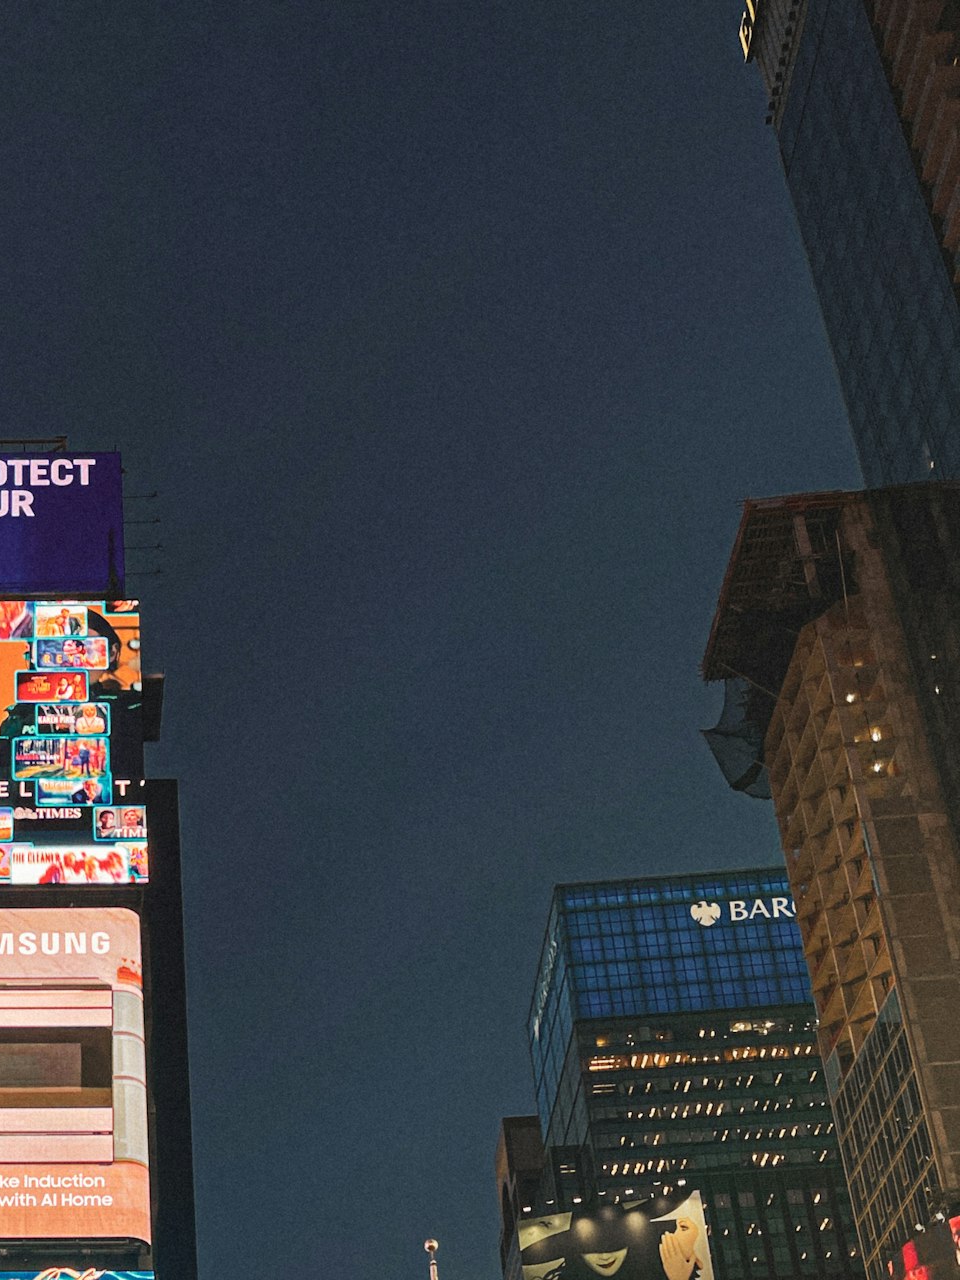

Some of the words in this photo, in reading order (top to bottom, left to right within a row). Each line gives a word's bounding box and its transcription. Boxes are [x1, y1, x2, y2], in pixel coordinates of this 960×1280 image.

[36, 807, 82, 819] TIMES
[24, 1174, 105, 1189] Induction
[41, 1194, 57, 1207] AI
[61, 1192, 113, 1207] Home
